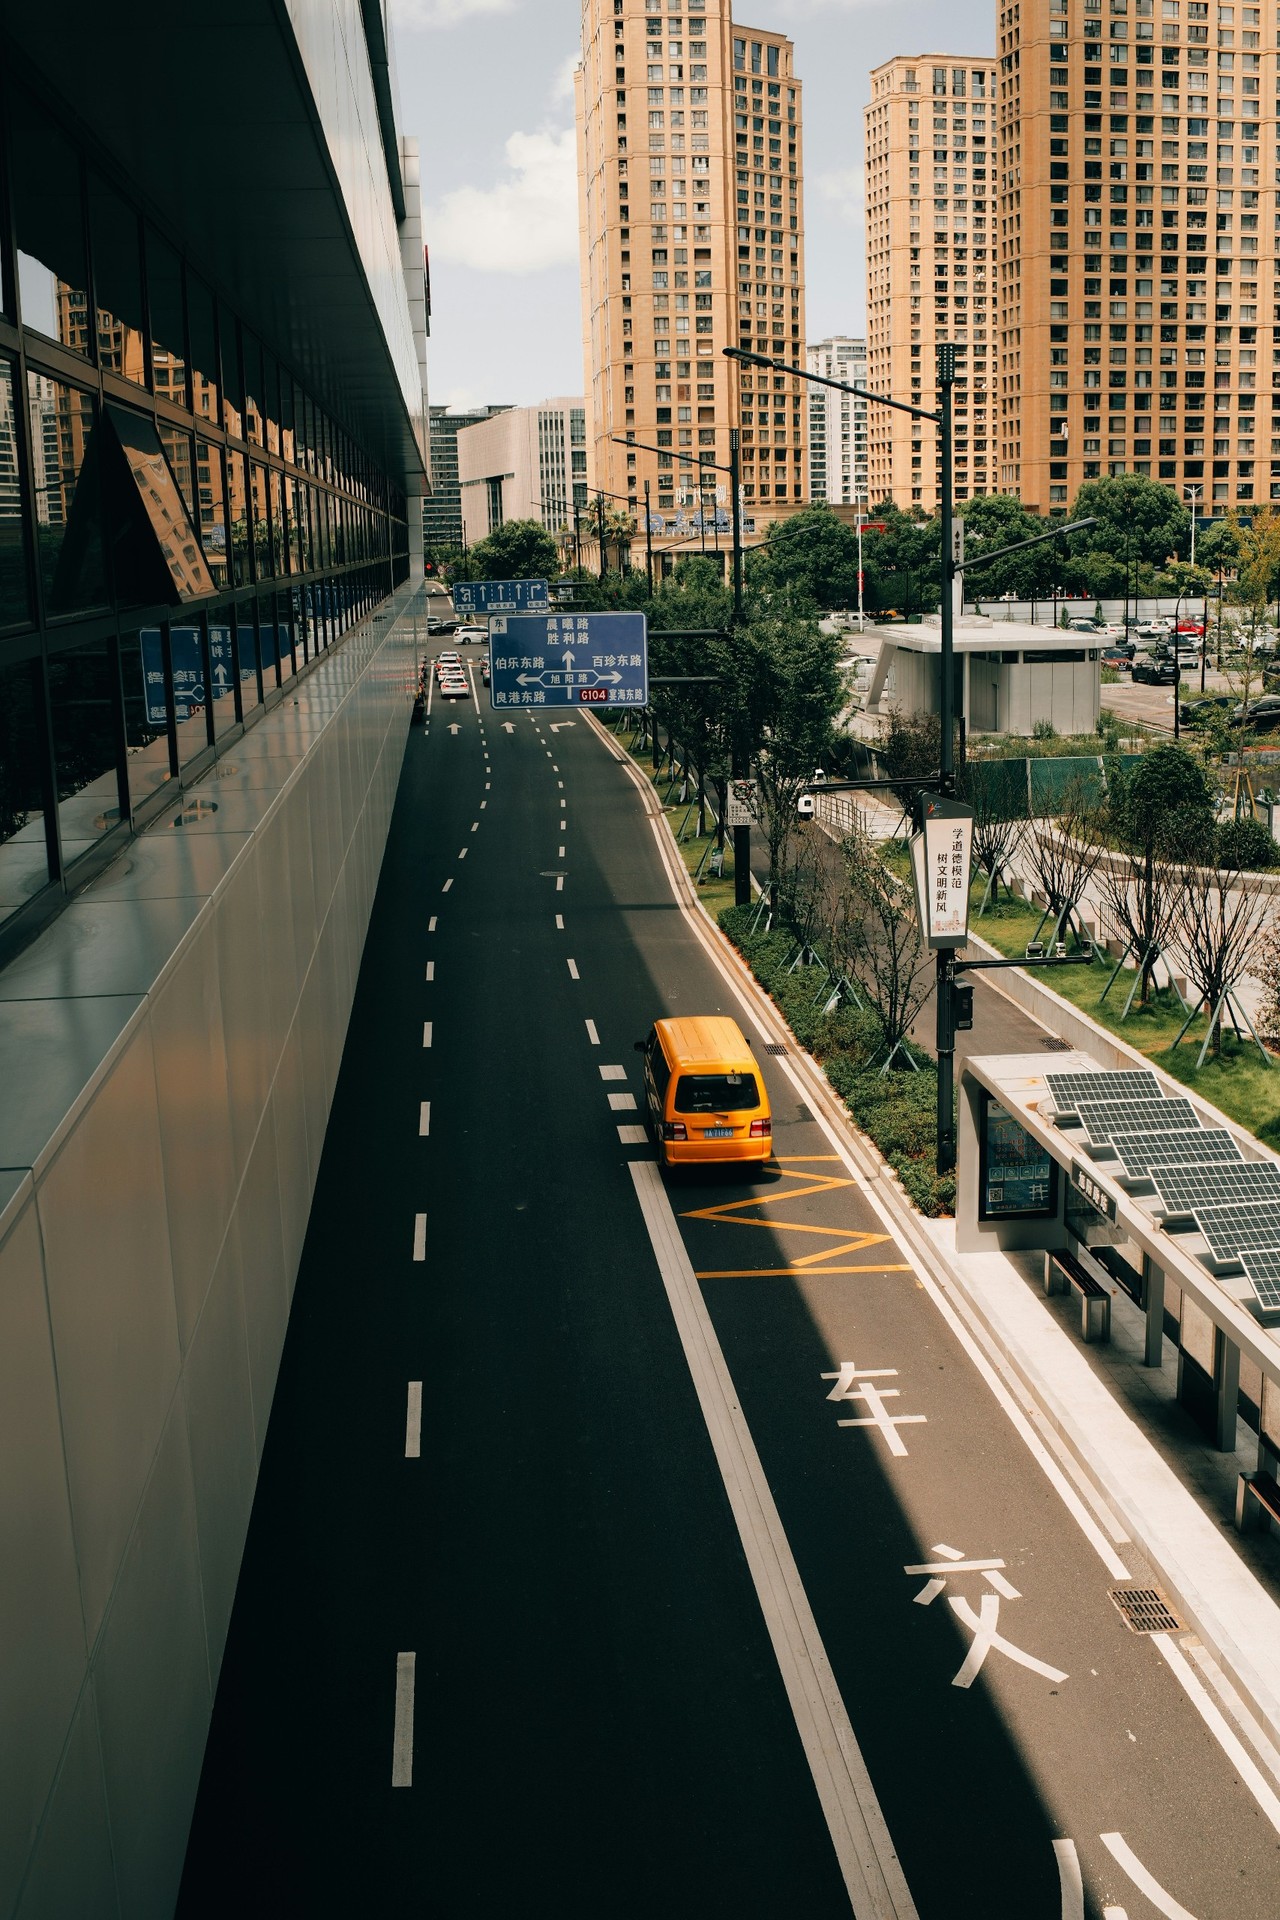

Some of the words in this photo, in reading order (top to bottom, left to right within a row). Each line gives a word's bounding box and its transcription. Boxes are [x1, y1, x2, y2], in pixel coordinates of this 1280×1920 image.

[494, 618, 503, 627] 东
[546, 618, 589, 631] 晨曦路
[546, 632, 589, 645] 胜利路
[495, 657, 545, 670] 伯乐东路
[592, 654, 642, 668] 百珍东路
[550, 673, 588, 684] 旭阳路
[496, 691, 546, 704] 良港东路
[581, 689, 607, 700] G104
[951, 828, 963, 889] 学道德模范
[935, 853, 948, 913] 树文明新风
[820, 1362, 927, 1456] 车
[904, 1544, 1069, 1688] 交
